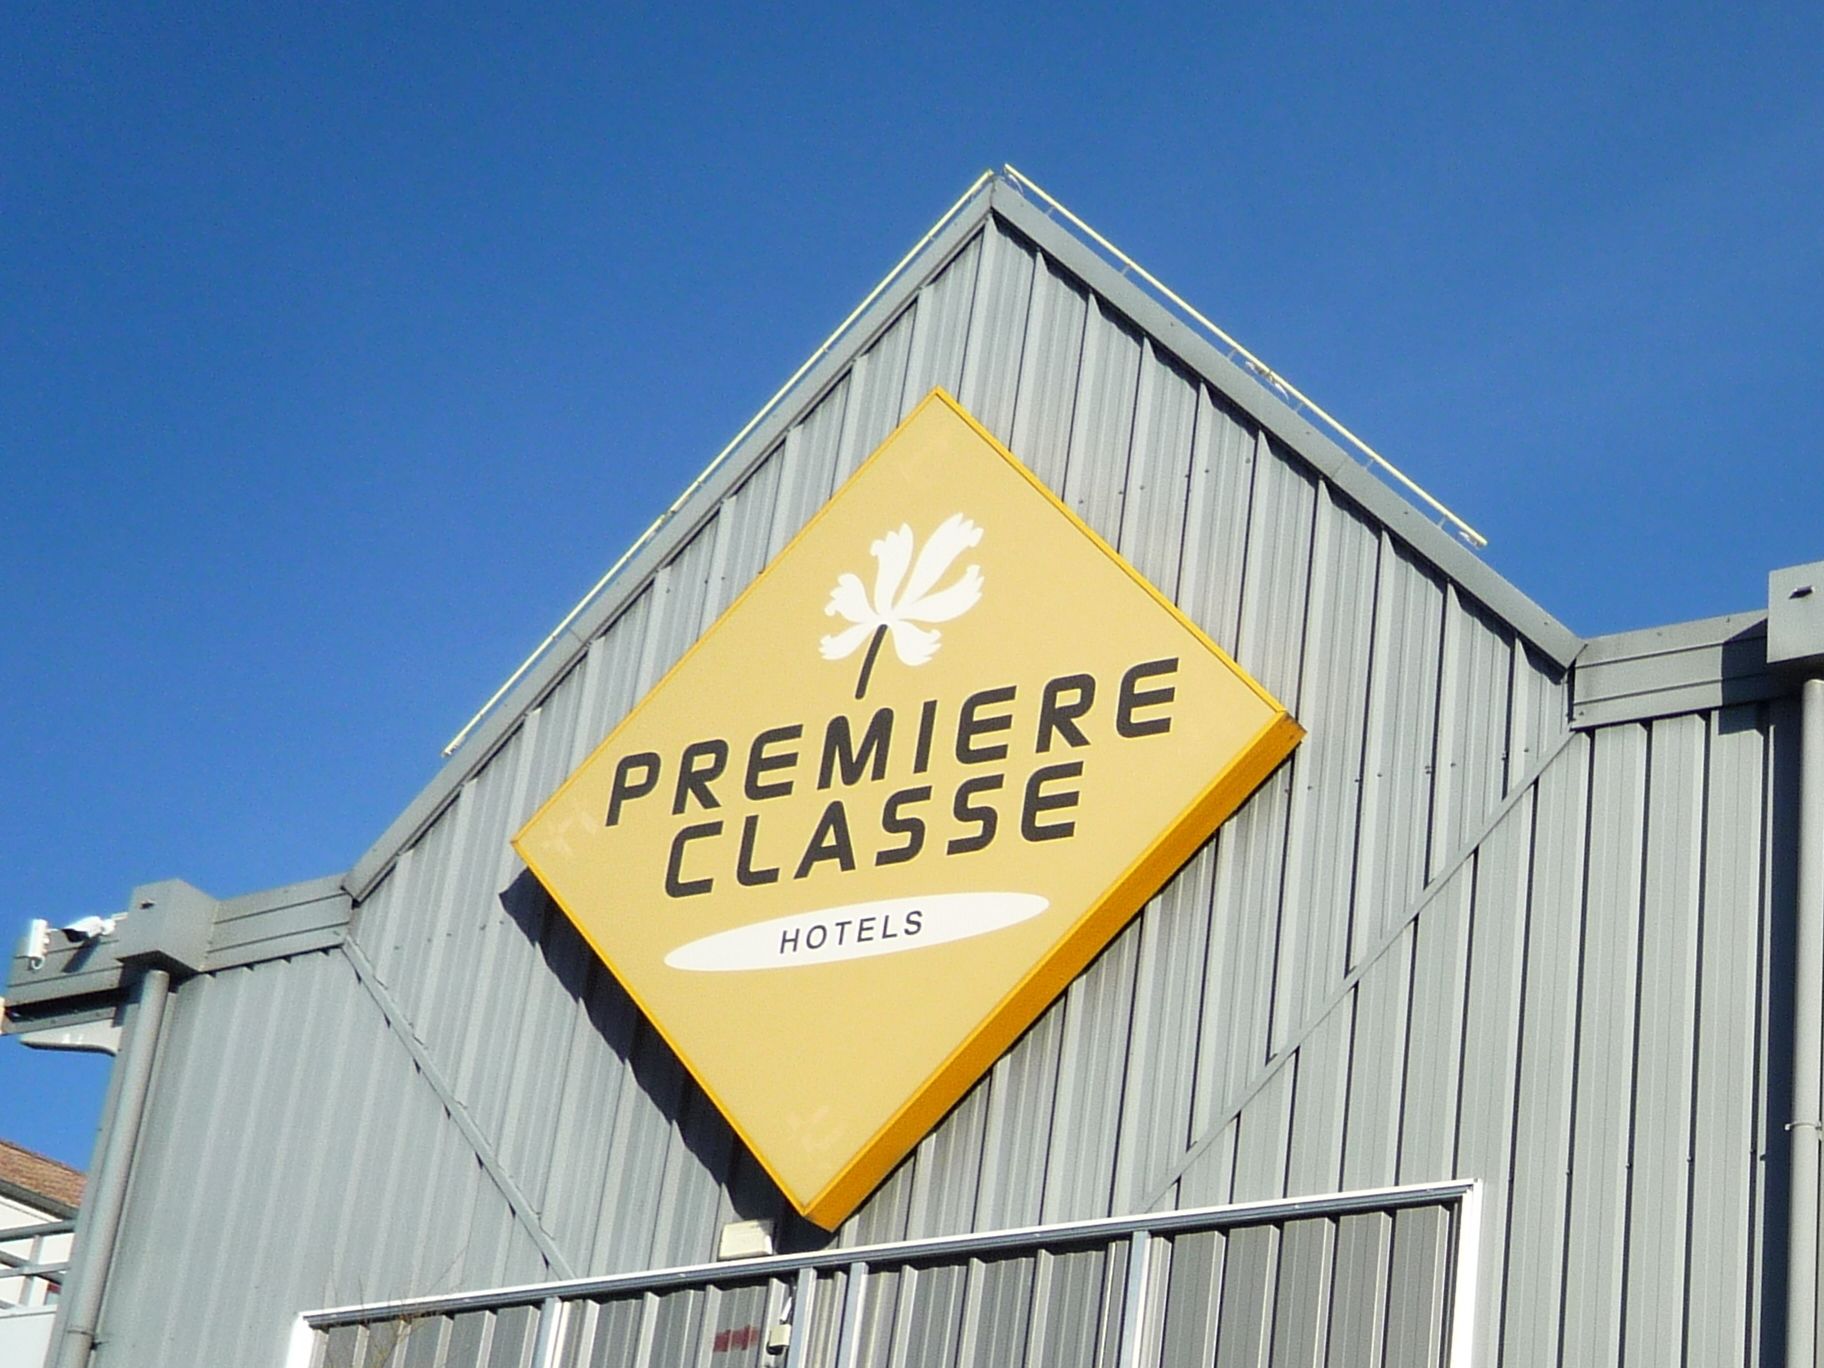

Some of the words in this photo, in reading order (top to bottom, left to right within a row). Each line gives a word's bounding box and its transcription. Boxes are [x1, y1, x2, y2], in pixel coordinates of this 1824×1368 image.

[605, 657, 1180, 827] PREMIERE
[665, 760, 1084, 898] CLASSE
[779, 909, 925, 955] HOTELS
